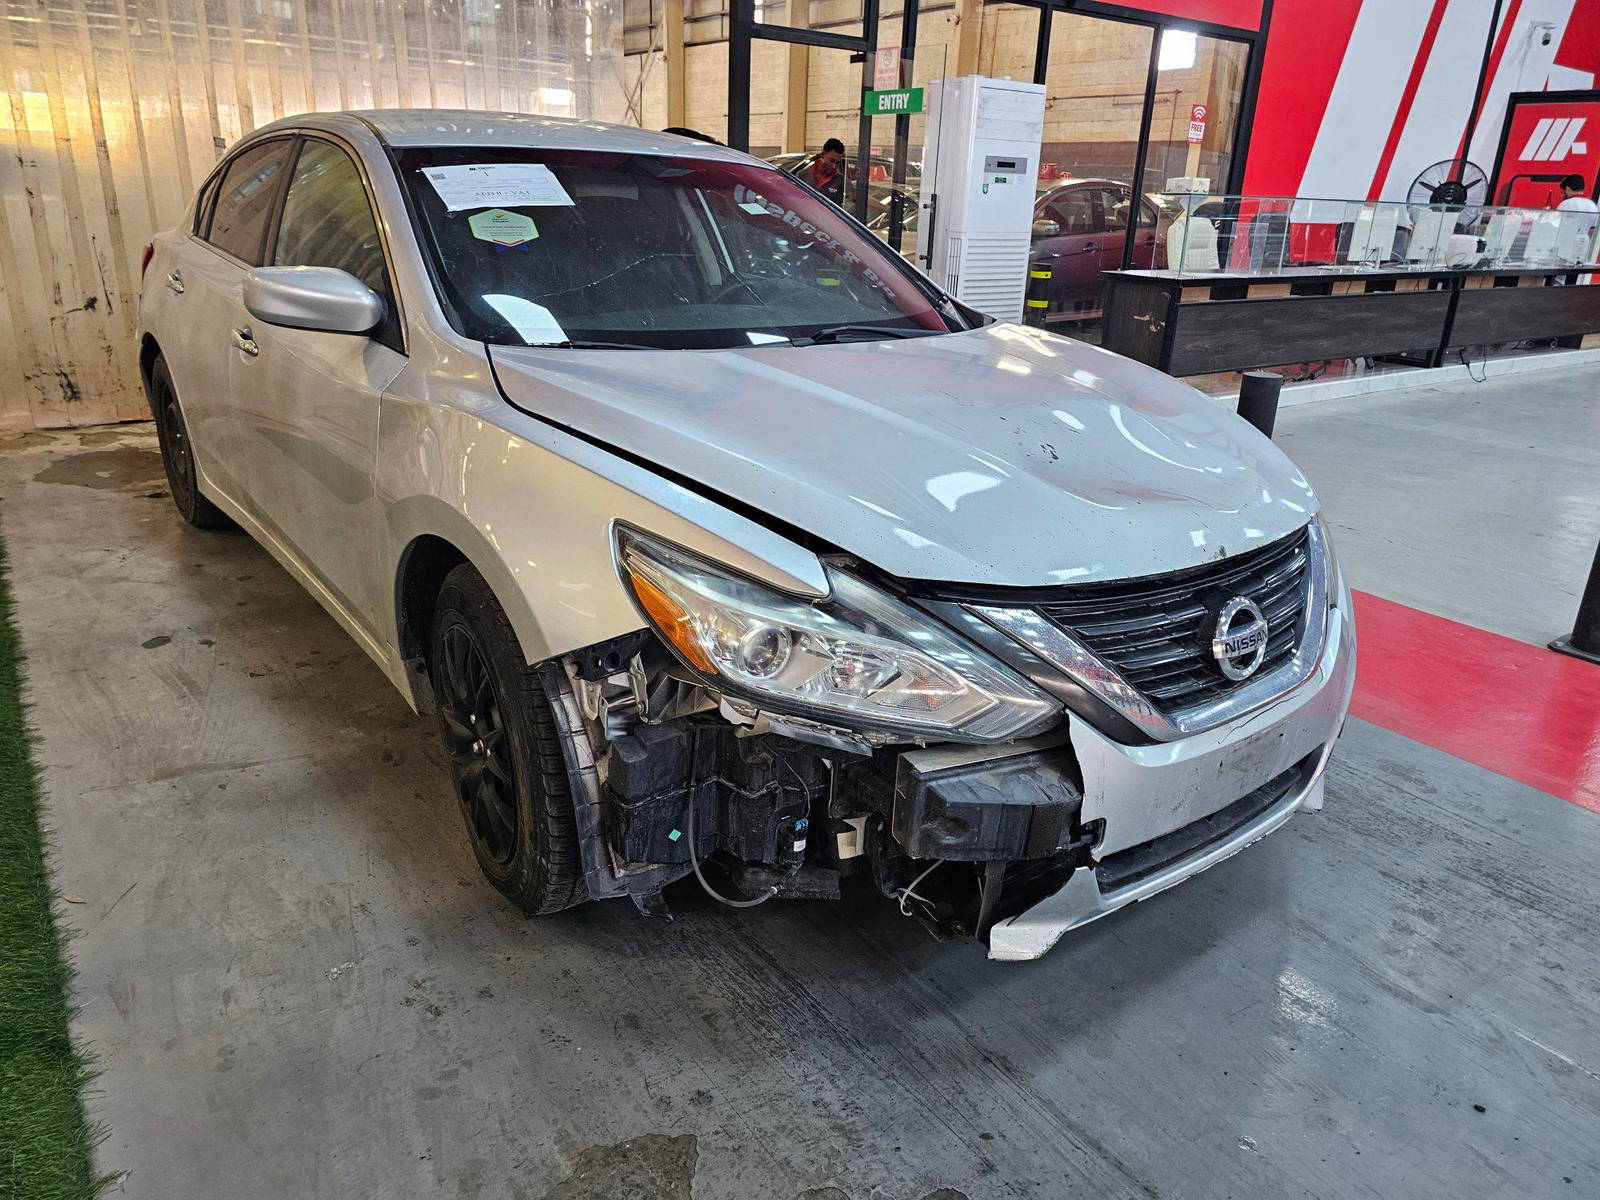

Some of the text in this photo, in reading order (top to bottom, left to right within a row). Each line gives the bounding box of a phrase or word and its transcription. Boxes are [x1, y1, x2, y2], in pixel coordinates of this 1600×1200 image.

[878, 93, 910, 110] ENTRY
[1191, 123, 1203, 132] FREE
[1225, 630, 1267, 653] NISSAN
